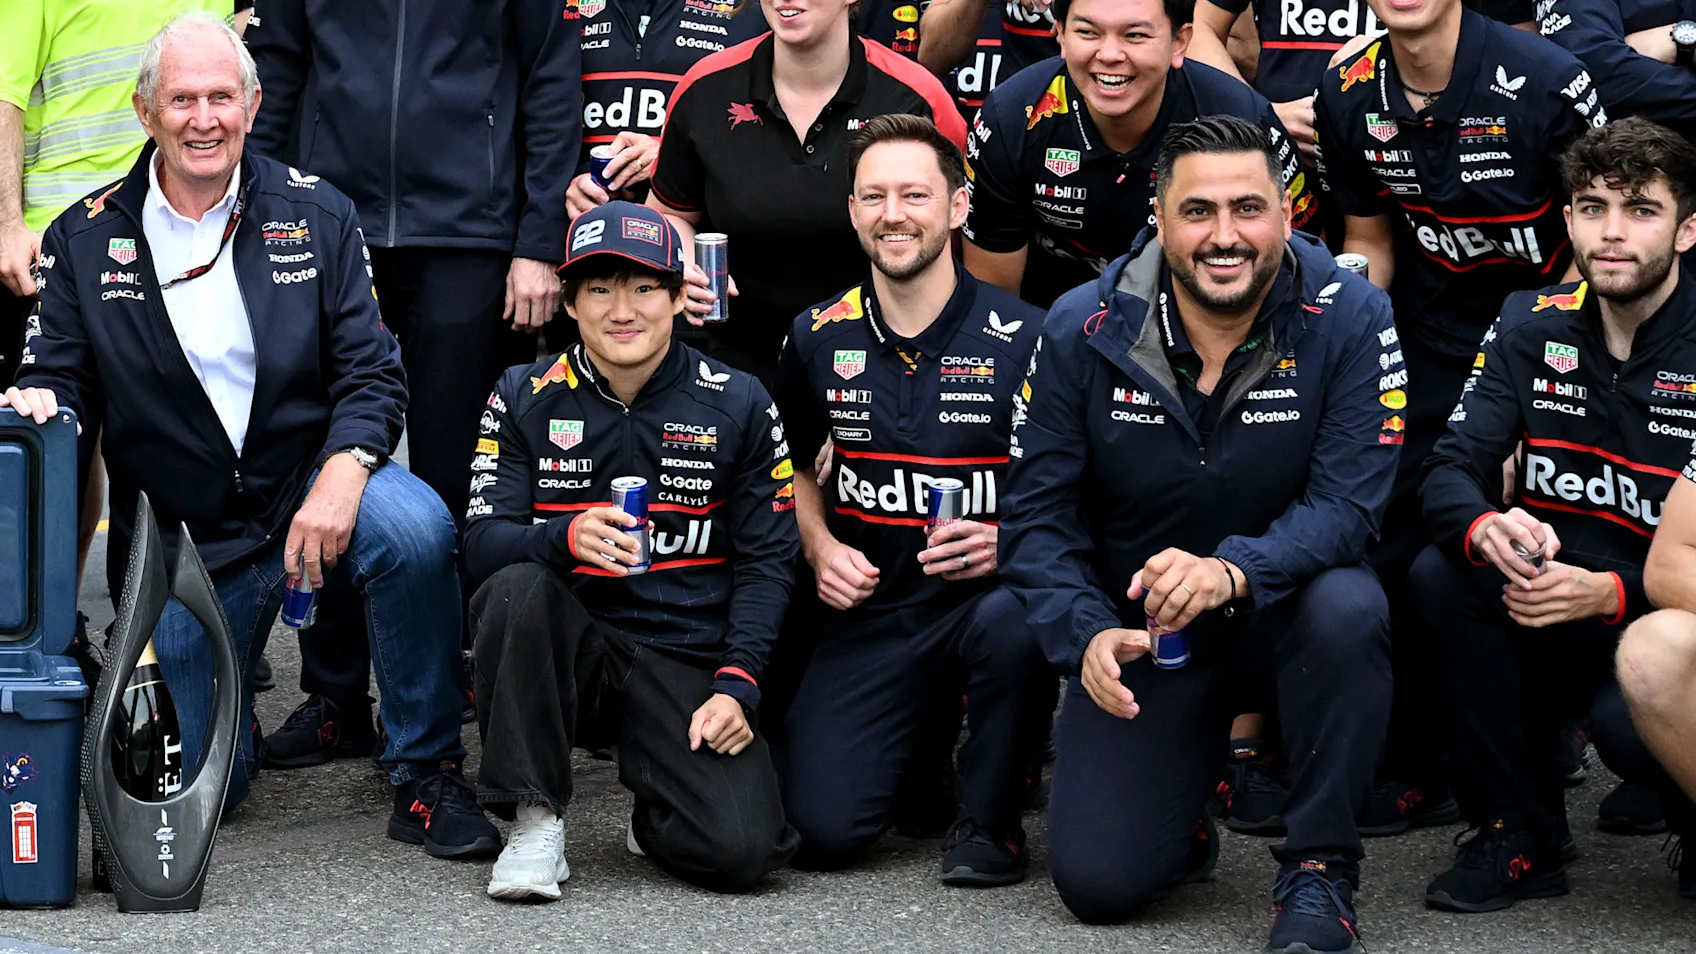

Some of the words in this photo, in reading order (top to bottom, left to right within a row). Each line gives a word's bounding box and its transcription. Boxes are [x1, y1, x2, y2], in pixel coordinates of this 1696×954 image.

[680, 21, 727, 36] HONDA
[1560, 70, 1592, 99] VISA
[1050, 151, 1077, 160] TAG
[1364, 150, 1399, 162] Mobil
[1459, 152, 1512, 163] HONDA
[1047, 160, 1078, 174] HEUER
[1473, 169, 1514, 180] Gate.io
[1035, 183, 1071, 198] Mobil
[1033, 200, 1084, 214] ORACLE
[261, 219, 307, 233] ORACLE
[626, 219, 660, 231] ORACLE
[571, 218, 606, 252] 22
[268, 250, 314, 265] HONDA
[101, 271, 135, 286] Mobil
[101, 290, 145, 301] ORACLE
[1160, 302, 1174, 346] 1Password
[983, 327, 1013, 343] CASTORE
[1377, 327, 1397, 347] VISA
[836, 351, 864, 363] TAG
[1548, 344, 1576, 358] TAG
[941, 356, 995, 367] ORACLE
[1546, 355, 1578, 372] HEUER
[834, 363, 866, 378] HEUER
[1533, 378, 1573, 397] Mobil
[826, 389, 856, 402] Mobil
[940, 393, 994, 402] HONDA
[1113, 386, 1152, 406] Mobil
[830, 410, 870, 420] ORACLE
[1532, 399, 1586, 417] ORACLE
[950, 411, 991, 424] Gate.io
[1111, 410, 1165, 424] ORACLE
[1255, 409, 1301, 424] Gate.io
[551, 420, 582, 432] TAG
[664, 423, 717, 436] ORACLE
[550, 431, 582, 447] HEUER
[662, 443, 717, 452] RACING
[539, 457, 578, 472] Mobil
[661, 457, 715, 470] HONDA
[538, 479, 591, 489] ORACLE
[1526, 454, 1616, 506] Red
[838, 464, 908, 512] Red
[658, 492, 708, 506] CARLYLE
